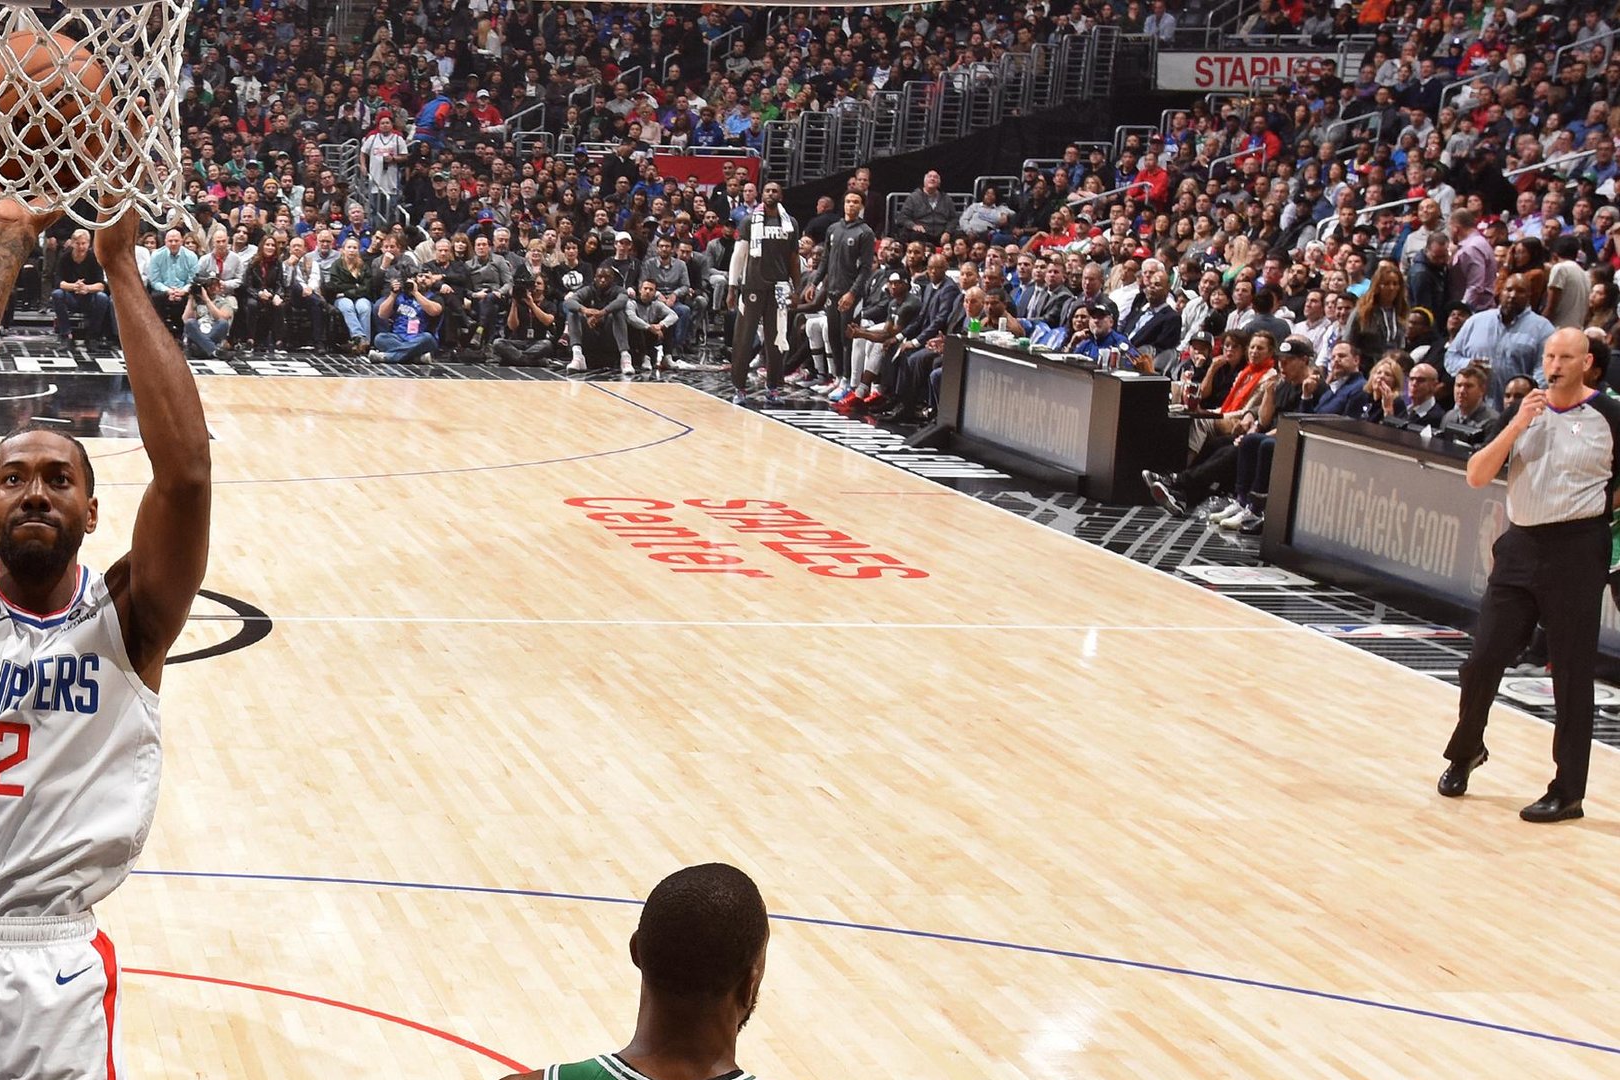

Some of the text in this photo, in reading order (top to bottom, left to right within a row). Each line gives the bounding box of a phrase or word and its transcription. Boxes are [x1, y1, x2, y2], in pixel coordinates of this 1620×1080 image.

[1195, 56, 1325, 87] STAPLS
[563, 496, 775, 578] Center
[683, 498, 931, 579] STAPLES
[1297, 460, 1461, 578] NBATickets.com
